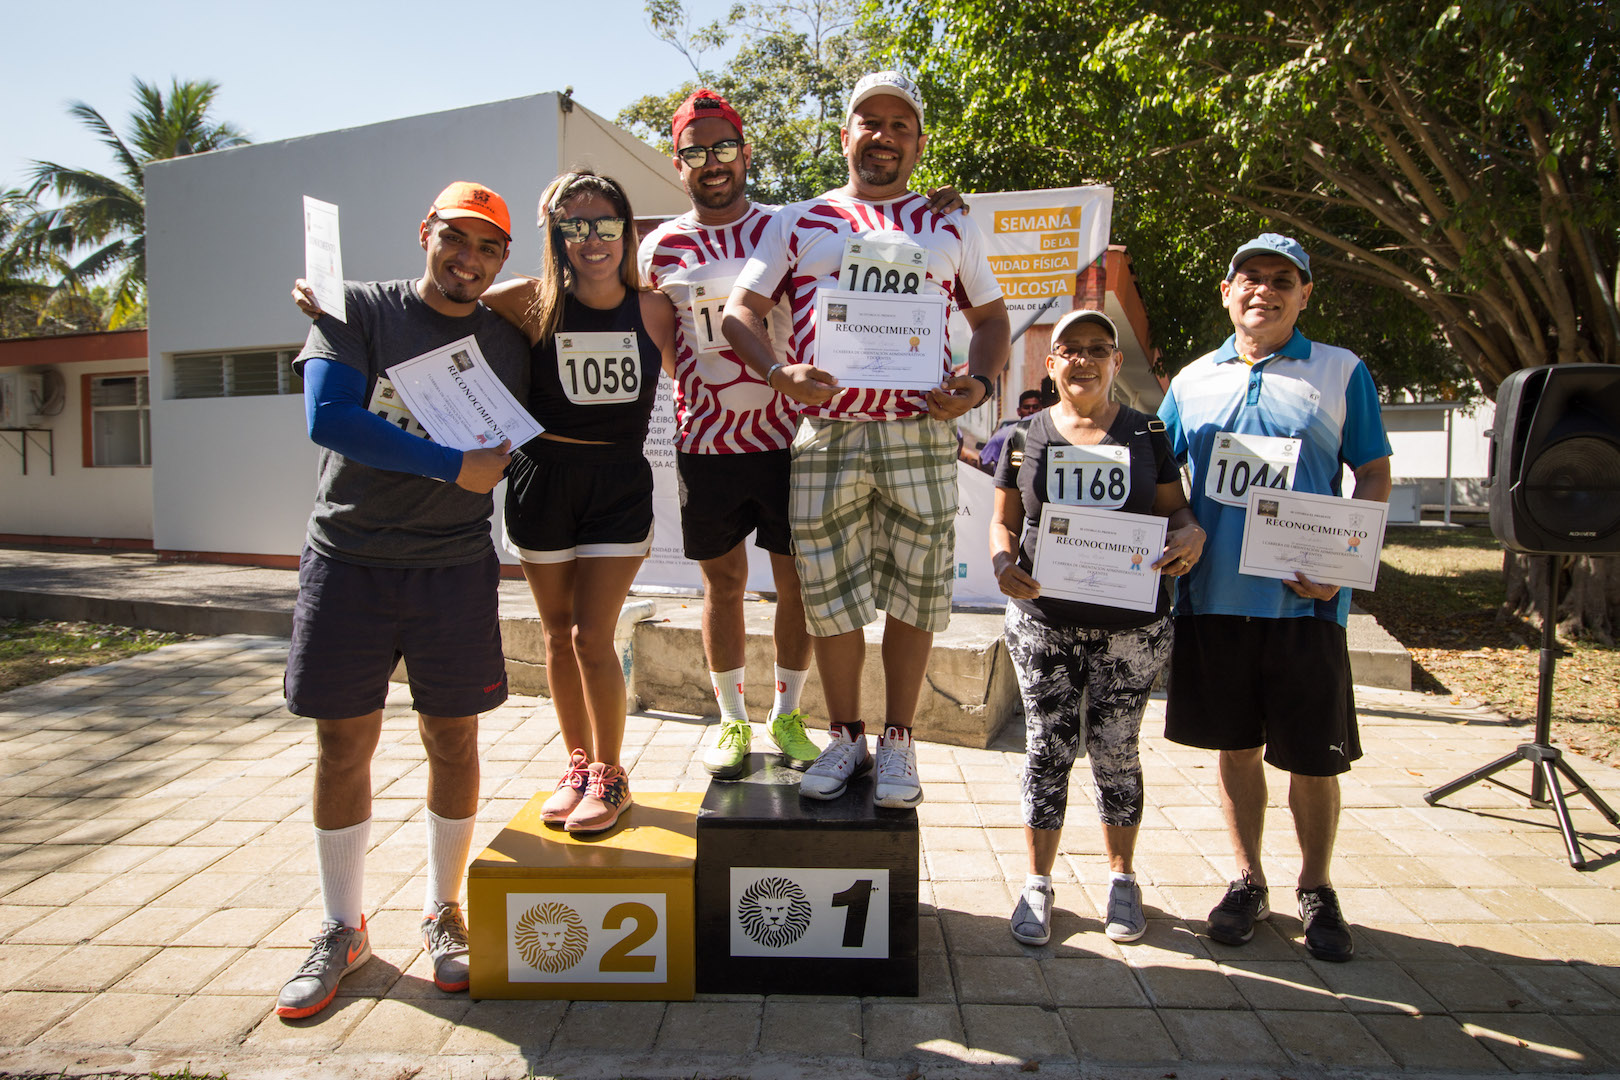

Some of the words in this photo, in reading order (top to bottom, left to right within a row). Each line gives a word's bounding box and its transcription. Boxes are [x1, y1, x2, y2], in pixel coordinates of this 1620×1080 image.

[1000, 214, 1072, 231] SEMANA
[1043, 238, 1056, 248] DE
[1059, 237, 1071, 246] LA
[990, 259, 1030, 271] VIDAD
[1033, 256, 1070, 270] FÍSICA
[848, 264, 919, 294] 1088
[835, 324, 931, 336] RECONOCIMIENTO
[566, 357, 638, 395] 1058
[447, 365, 507, 442] RECONOCIMIENTO
[1055, 467, 1125, 500] 1168
[1216, 459, 1289, 497] 1044
[1266, 518, 1368, 539] RECONOCIMIENTO
[1056, 536, 1149, 555] RECONOCIMIENTO
[830, 879, 873, 948] 1
[598, 902, 658, 972] 2
